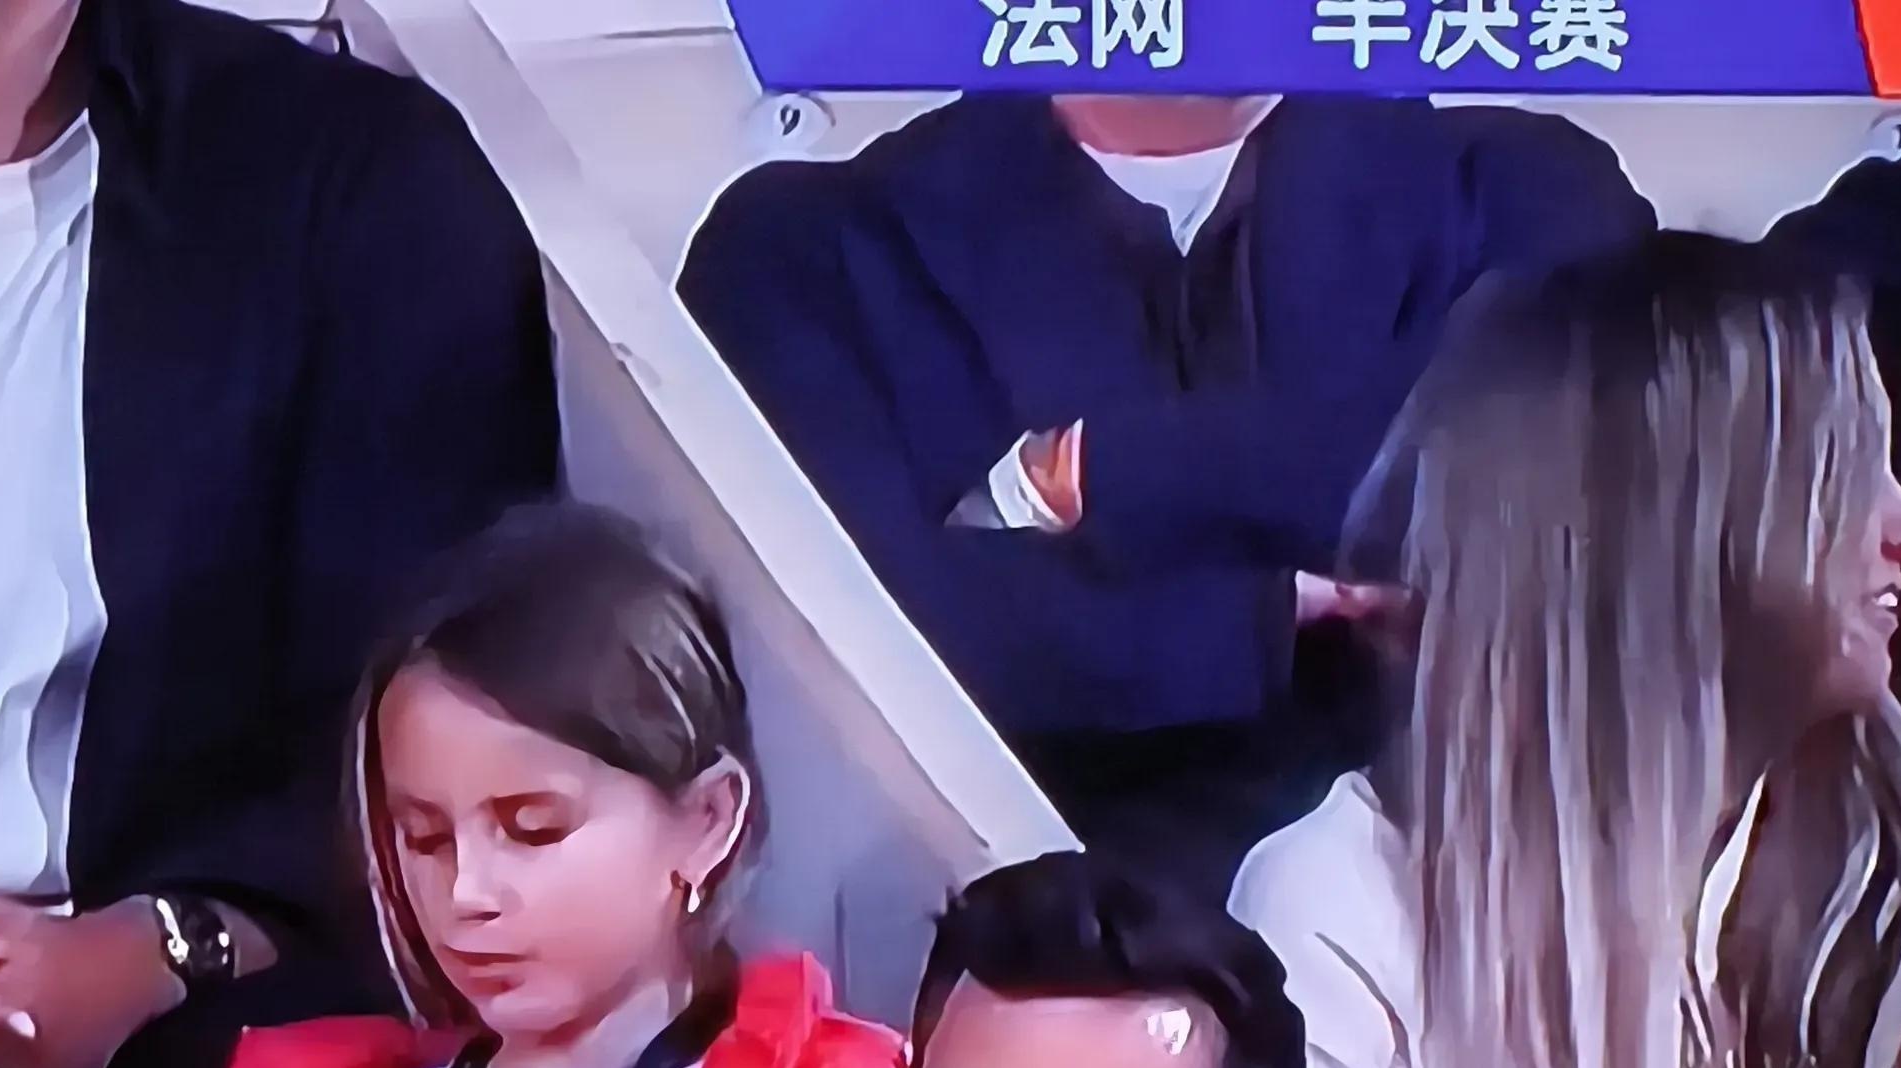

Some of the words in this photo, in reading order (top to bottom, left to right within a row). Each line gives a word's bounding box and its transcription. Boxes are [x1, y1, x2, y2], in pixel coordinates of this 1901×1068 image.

[981, 0, 1184, 69] 法网
[1311, 0, 1630, 71] 半决赛
